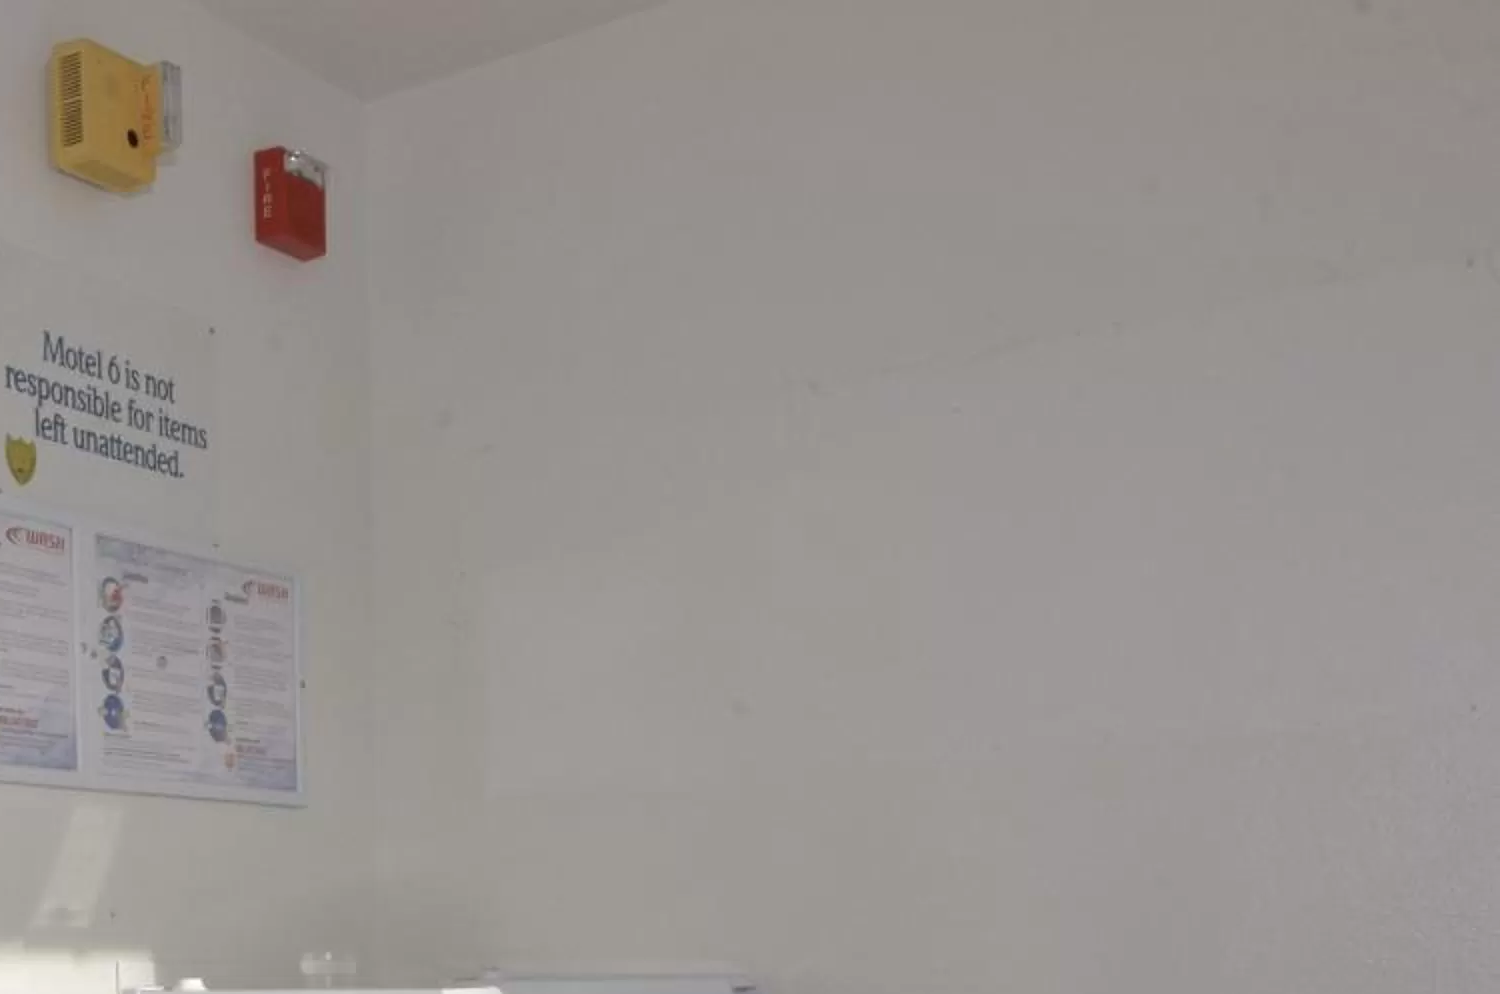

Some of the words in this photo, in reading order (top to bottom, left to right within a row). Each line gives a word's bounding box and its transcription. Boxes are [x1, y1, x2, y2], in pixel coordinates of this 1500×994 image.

[42, 330, 102, 380] Motel
[107, 355, 121, 384] 6
[125, 360, 141, 391] is
[145, 375, 176, 403] not
[5, 364, 122, 423] responsible
[127, 400, 155, 433] for
[159, 408, 208, 450] items
[34, 408, 68, 446] left
[72, 426, 185, 479] unattended.
